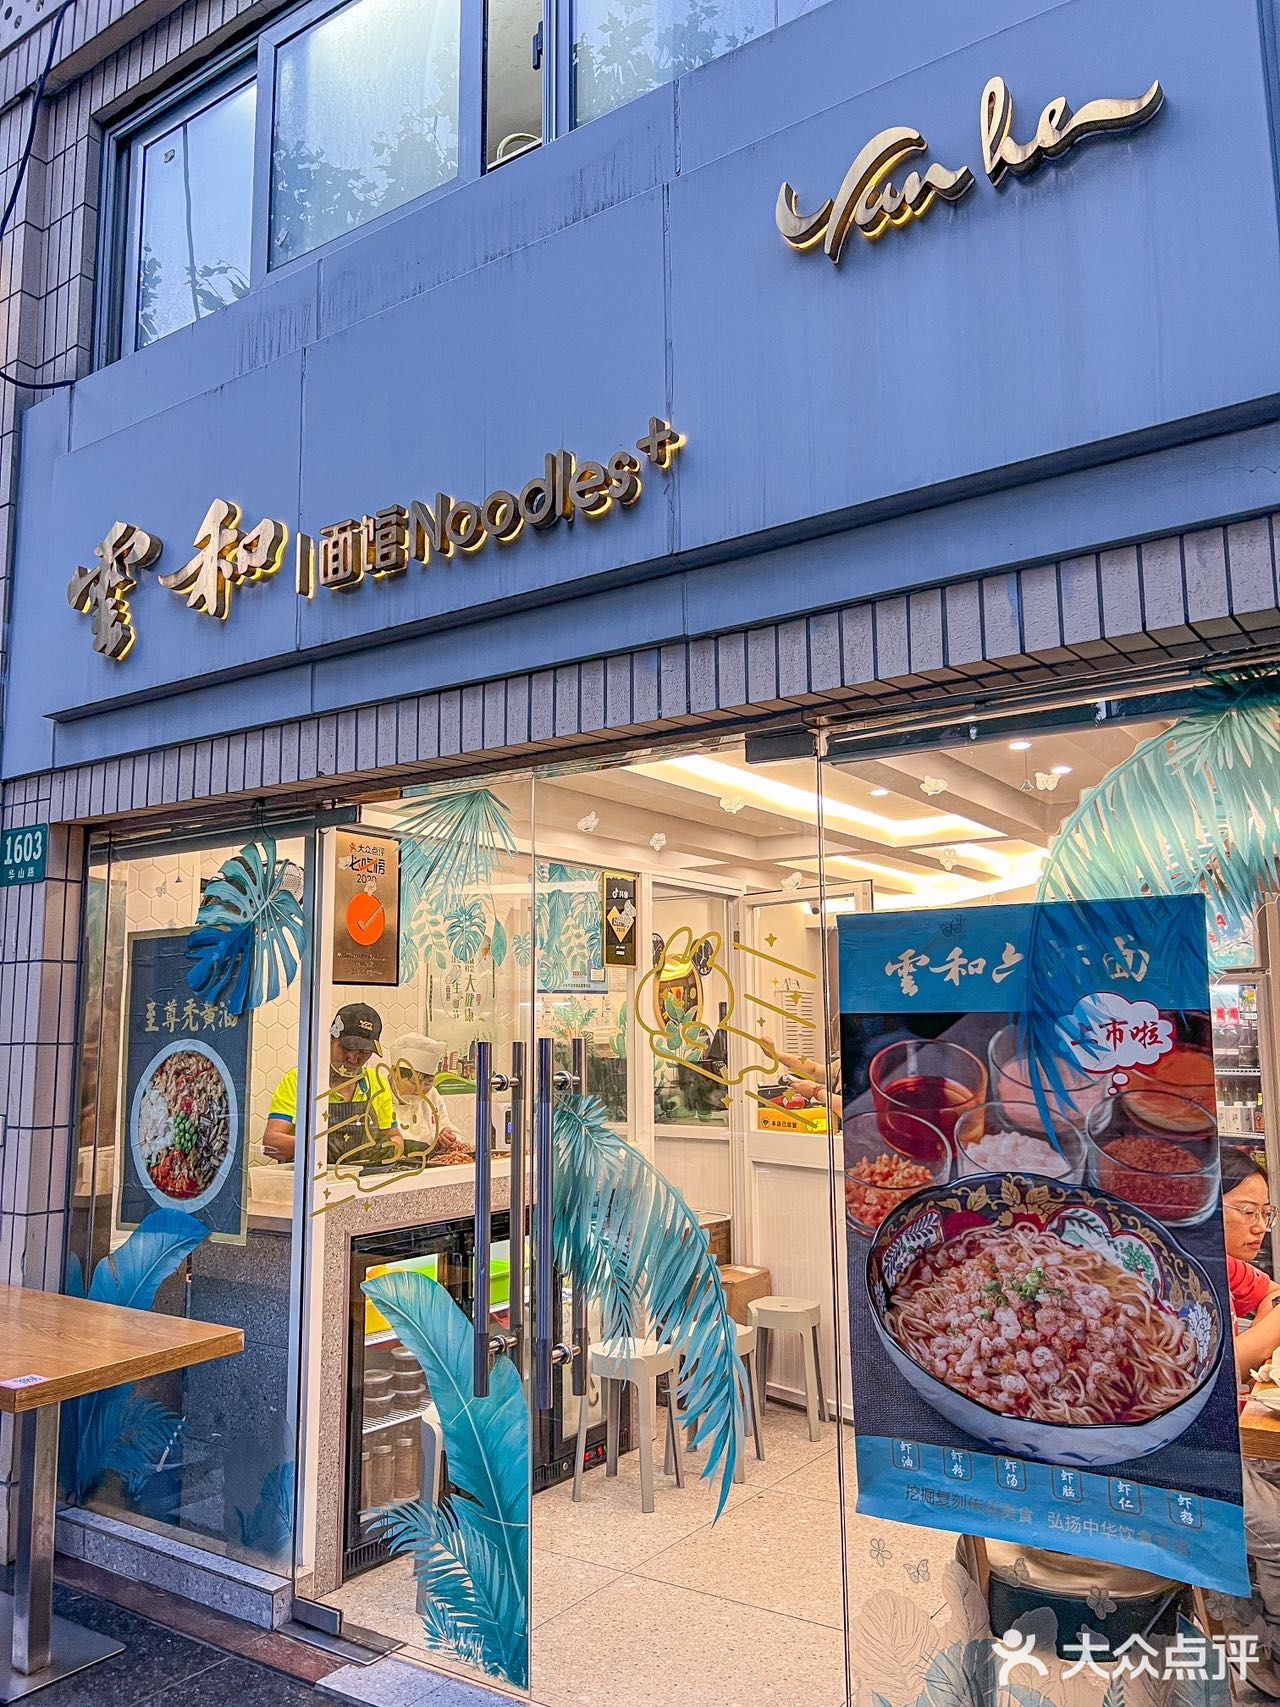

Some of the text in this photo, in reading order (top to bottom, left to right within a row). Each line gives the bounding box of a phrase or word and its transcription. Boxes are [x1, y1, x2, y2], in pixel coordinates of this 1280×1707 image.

[980, 76, 1164, 187] he
[4, 831, 42, 865] 1603
[8, 867, 35, 880] 华山路
[1117, 1480, 1134, 1510] 虾仁
